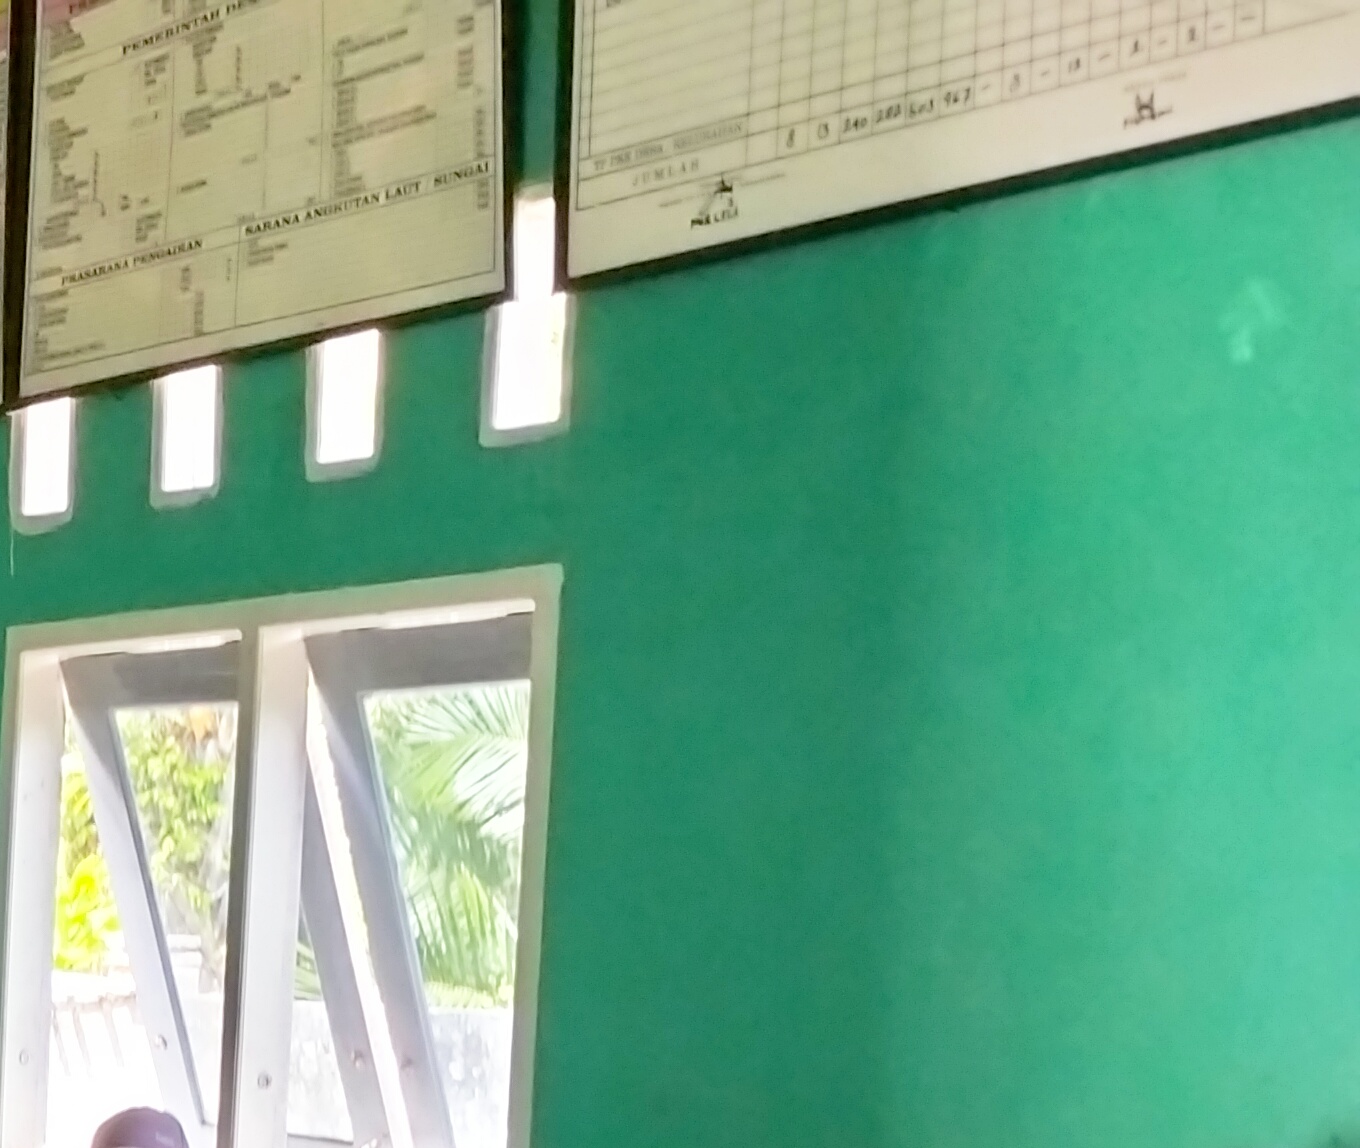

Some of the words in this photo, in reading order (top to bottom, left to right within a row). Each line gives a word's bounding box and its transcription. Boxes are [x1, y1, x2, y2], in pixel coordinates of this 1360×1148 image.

[122, 8, 220, 55] PEMERINTAH
[244, 213, 301, 236] SARANA
[304, 191, 380, 222] ANGKUTAN
[384, 181, 422, 200] LAUT
[433, 160, 489, 188] SUNGAI
